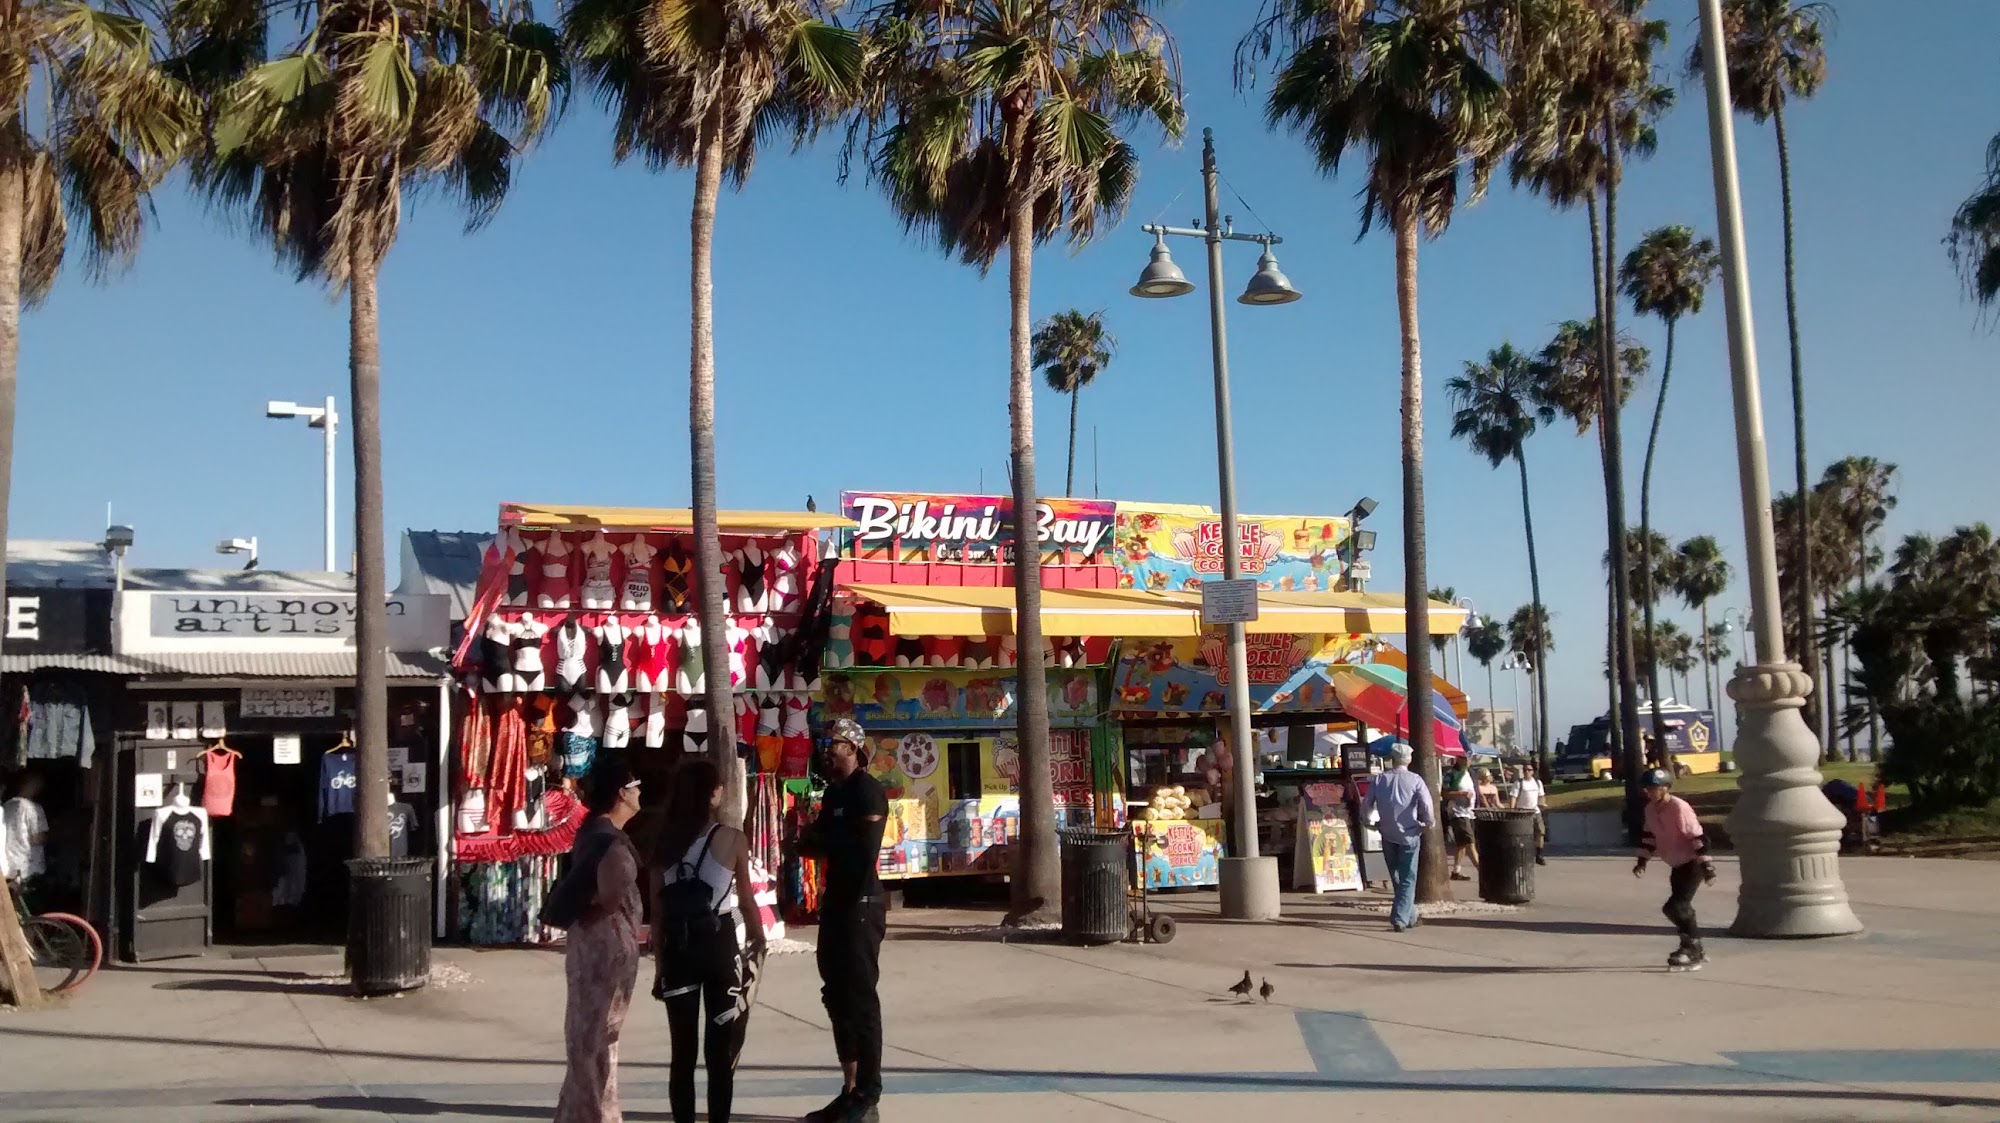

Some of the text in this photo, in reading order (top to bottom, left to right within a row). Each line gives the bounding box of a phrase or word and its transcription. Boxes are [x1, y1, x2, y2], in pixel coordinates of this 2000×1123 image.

[853, 497, 1001, 541] Bikini
[1200, 523, 1260, 545] KELE
[937, 544, 986, 559] Cusom
[1206, 543, 1253, 556] CN
[1199, 560, 1259, 571] COER
[628, 583, 649, 592] BUD
[1245, 633, 1292, 650] TTLE
[1246, 649, 1283, 666] ORN
[1223, 669, 1285, 681] CRNER
[1049, 729, 1091, 757] TTLE
[1348, 751, 1367, 760] ATM
[1050, 760, 1085, 783] ORN
[984, 783, 1008, 792] Pick Up
[1052, 787, 1093, 804] RNER
